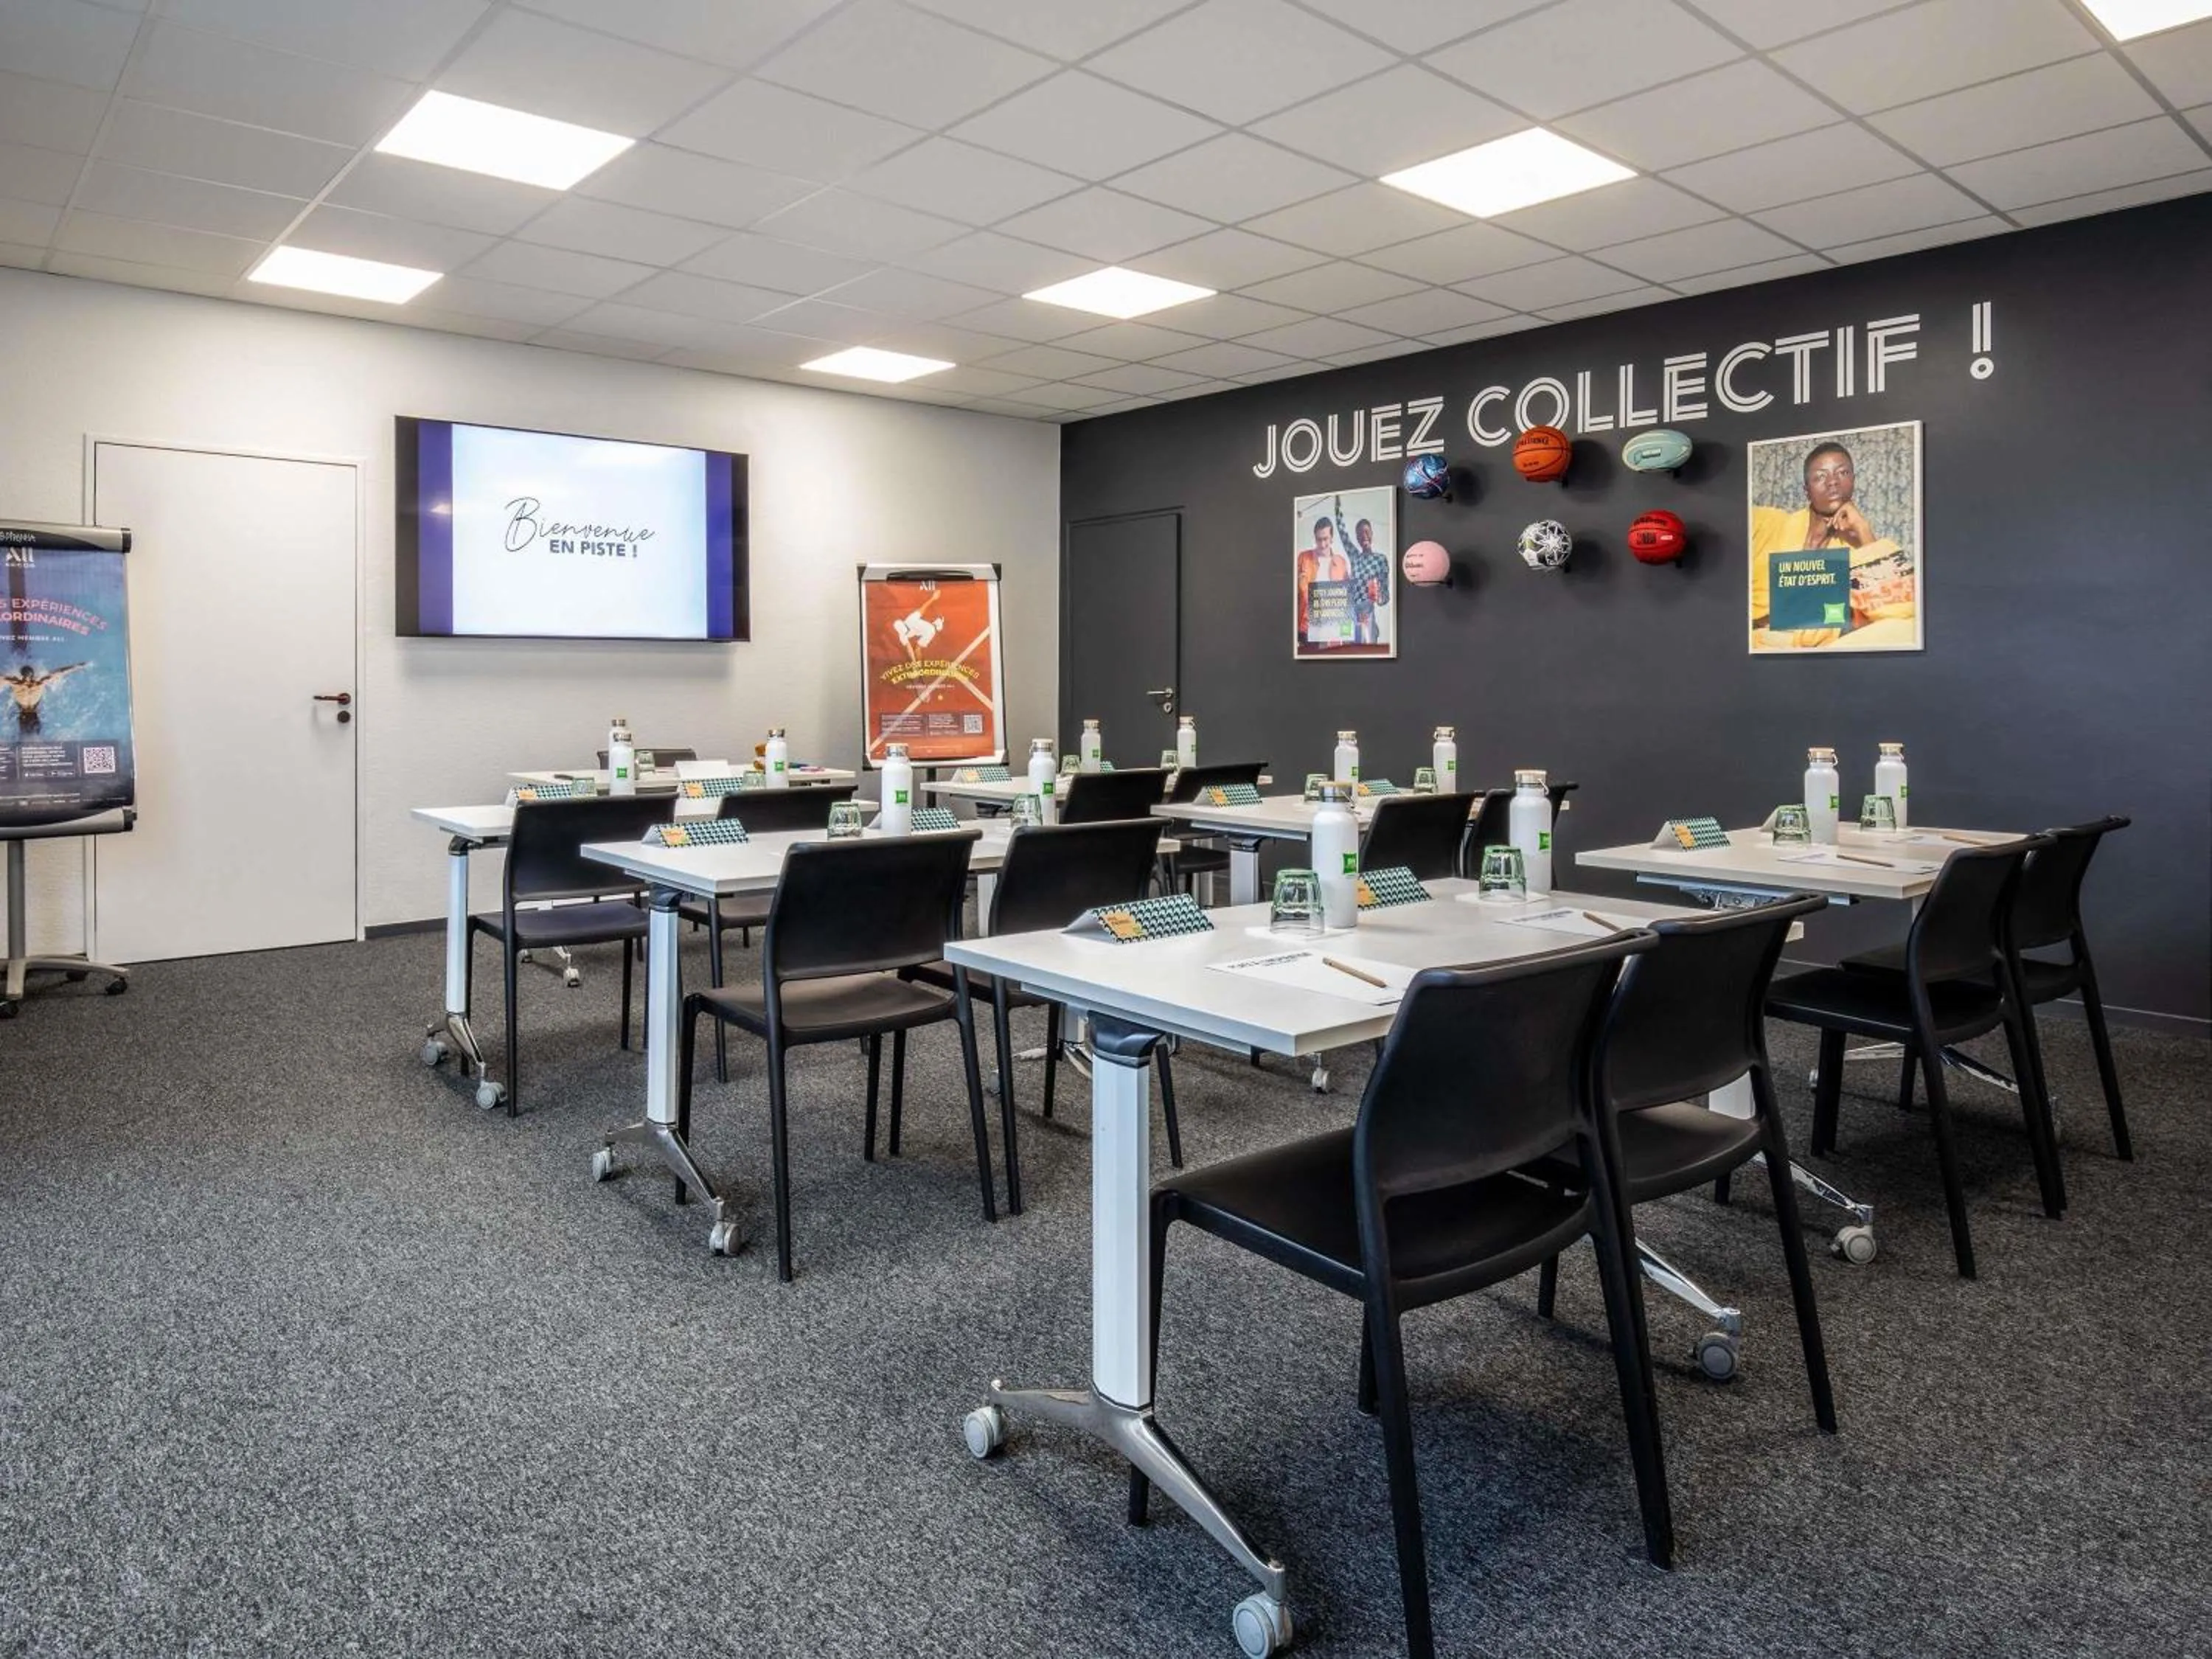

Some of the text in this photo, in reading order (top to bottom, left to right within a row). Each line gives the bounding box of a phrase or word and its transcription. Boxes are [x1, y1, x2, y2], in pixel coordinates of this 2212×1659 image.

[1253, 301, 1995, 479] JOUEZ COLLECTIF !
[504, 496, 655, 553] Bienvenue
[549, 539, 639, 558] EN PISTE !
[1779, 560, 1825, 573] UN NOUVEL
[1778, 574, 1796, 587] ÉTAT
[0, 611, 91, 636] ORDINAIRES
